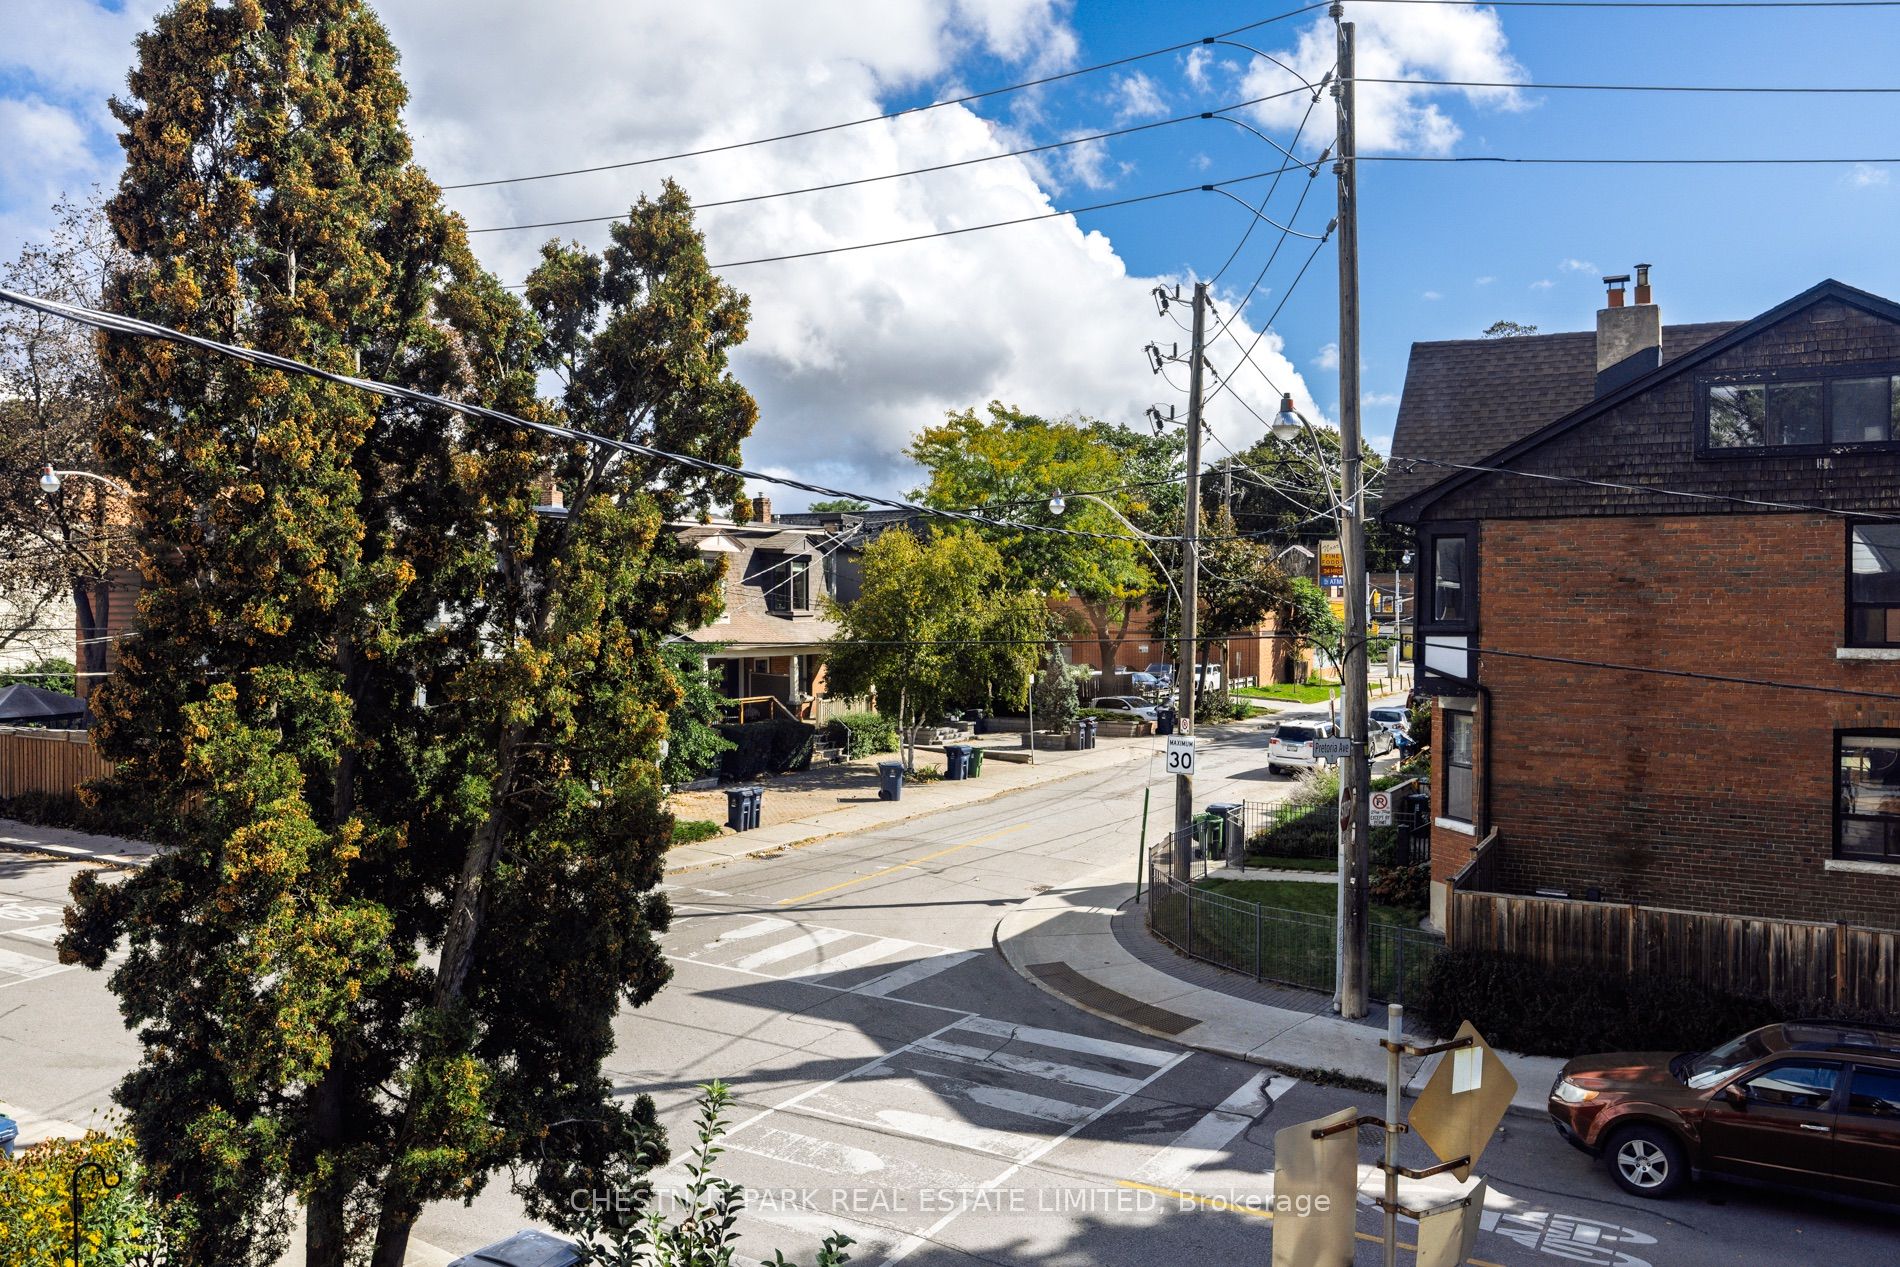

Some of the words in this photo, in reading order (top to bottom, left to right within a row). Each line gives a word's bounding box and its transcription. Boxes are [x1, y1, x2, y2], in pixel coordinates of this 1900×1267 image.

[1169, 739, 1193, 747] MAXIMUM
[1315, 742, 1337, 753] Pretoria
[1338, 742, 1349, 753] Ave
[1169, 751, 1192, 769] 30
